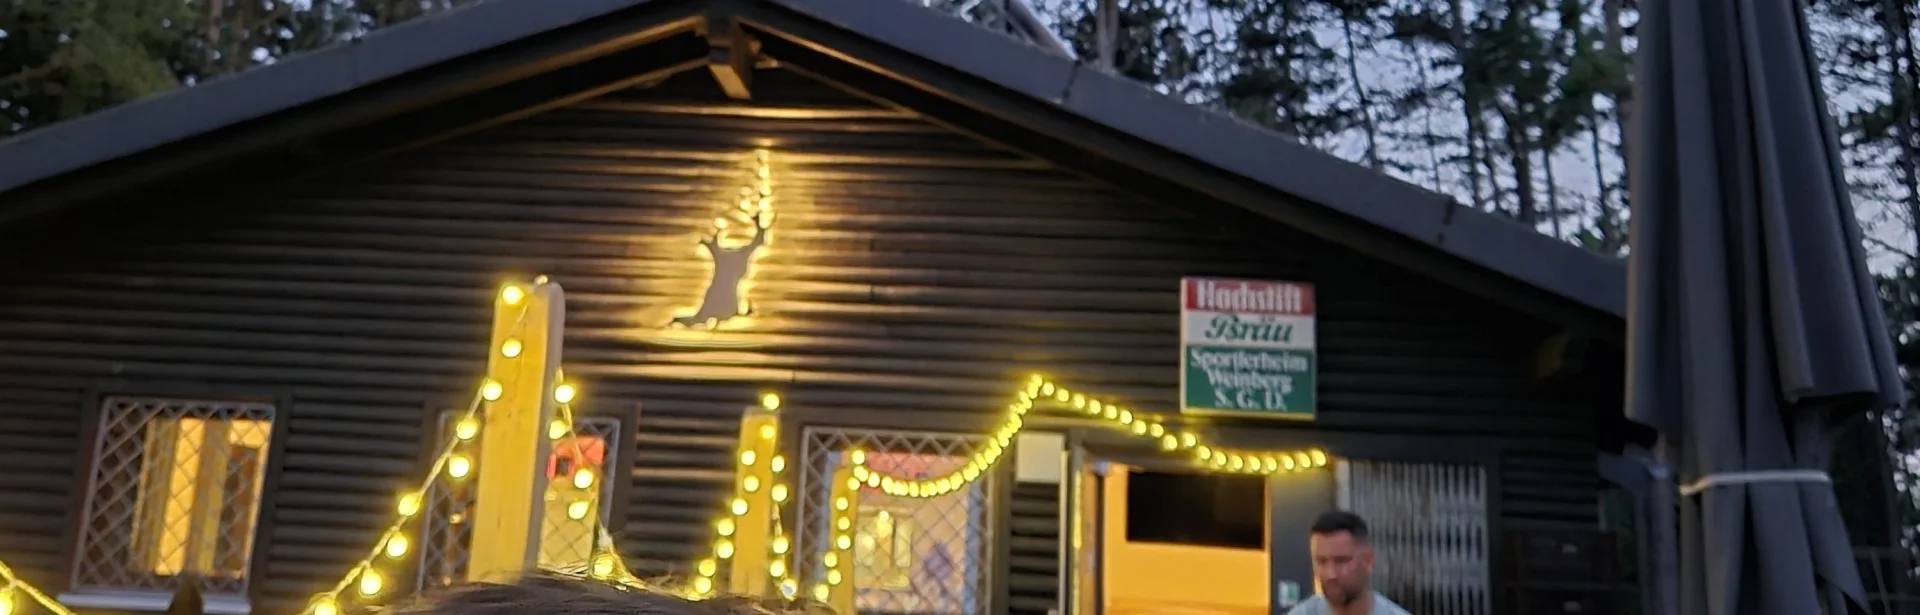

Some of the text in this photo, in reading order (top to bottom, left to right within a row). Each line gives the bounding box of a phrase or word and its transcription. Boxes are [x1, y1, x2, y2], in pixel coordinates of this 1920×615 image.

[1204, 314, 1293, 342] Bräu
[1190, 348, 1308, 373] Sportlerheim
[1206, 369, 1293, 394] Weinberg
